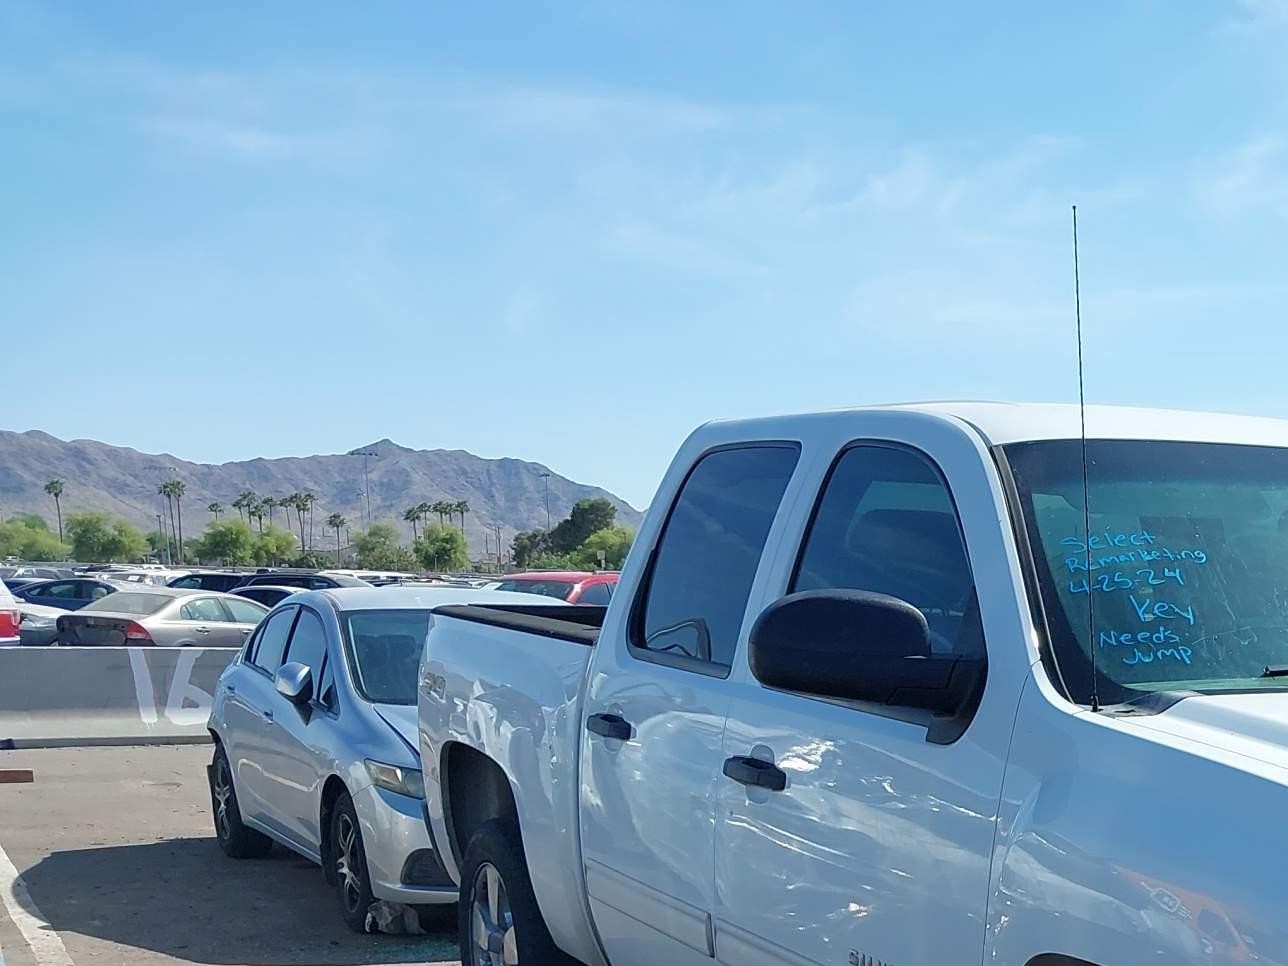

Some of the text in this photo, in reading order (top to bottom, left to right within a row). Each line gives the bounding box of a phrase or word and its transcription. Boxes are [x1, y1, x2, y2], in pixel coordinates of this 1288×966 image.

[1060, 529, 1155, 553] Select
[1065, 548, 1207, 573] Remarketing
[1130, 595, 1196, 625] Key
